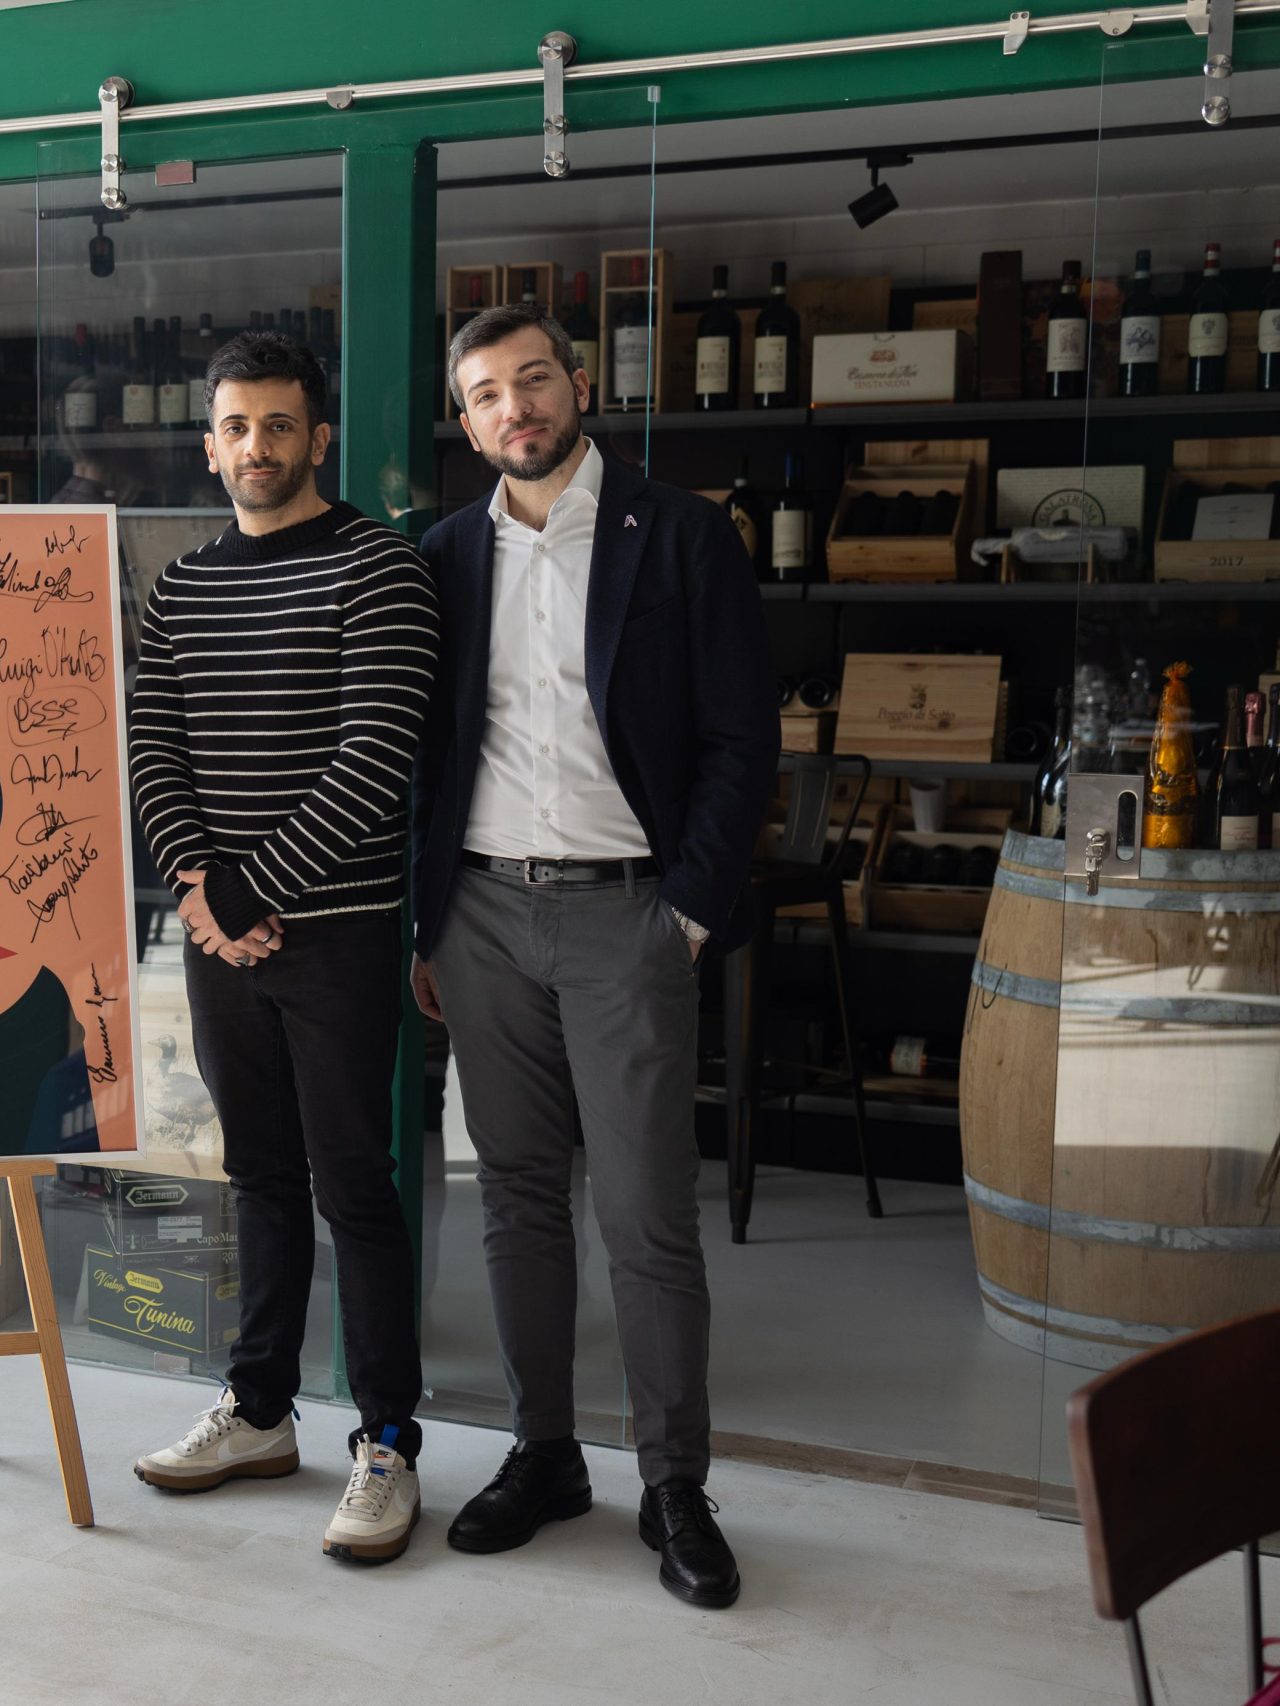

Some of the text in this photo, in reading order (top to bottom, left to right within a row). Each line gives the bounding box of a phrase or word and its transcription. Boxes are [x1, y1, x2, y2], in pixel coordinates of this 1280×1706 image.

[1209, 556, 1243, 567] 2017
[94, 1268, 126, 1293] Vintage
[124, 1295, 195, 1334] Tunina
